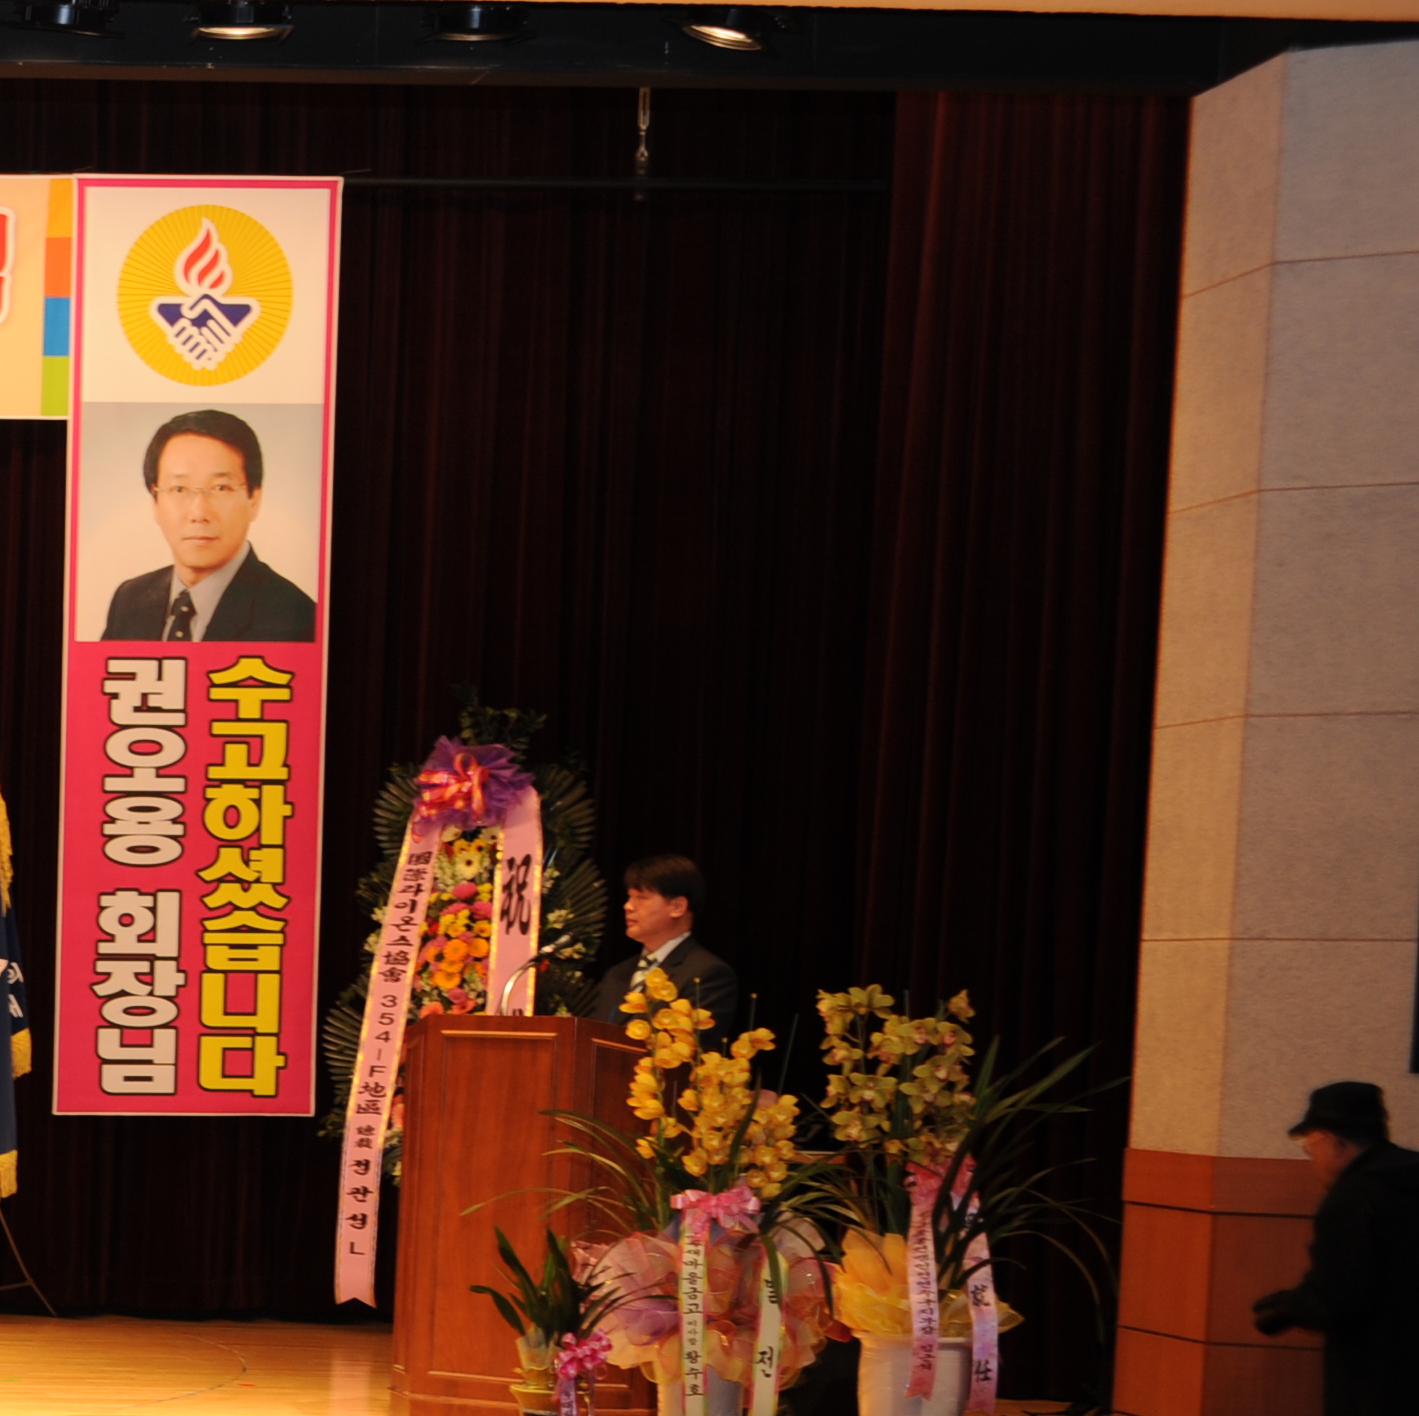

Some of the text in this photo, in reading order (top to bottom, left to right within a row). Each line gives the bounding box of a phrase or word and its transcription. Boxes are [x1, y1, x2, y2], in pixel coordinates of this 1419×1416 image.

[90, 657, 187, 1095] 권오용 회장님
[196, 656, 295, 1098] 수고하셨습니다
[499, 854, 532, 935] 祝
